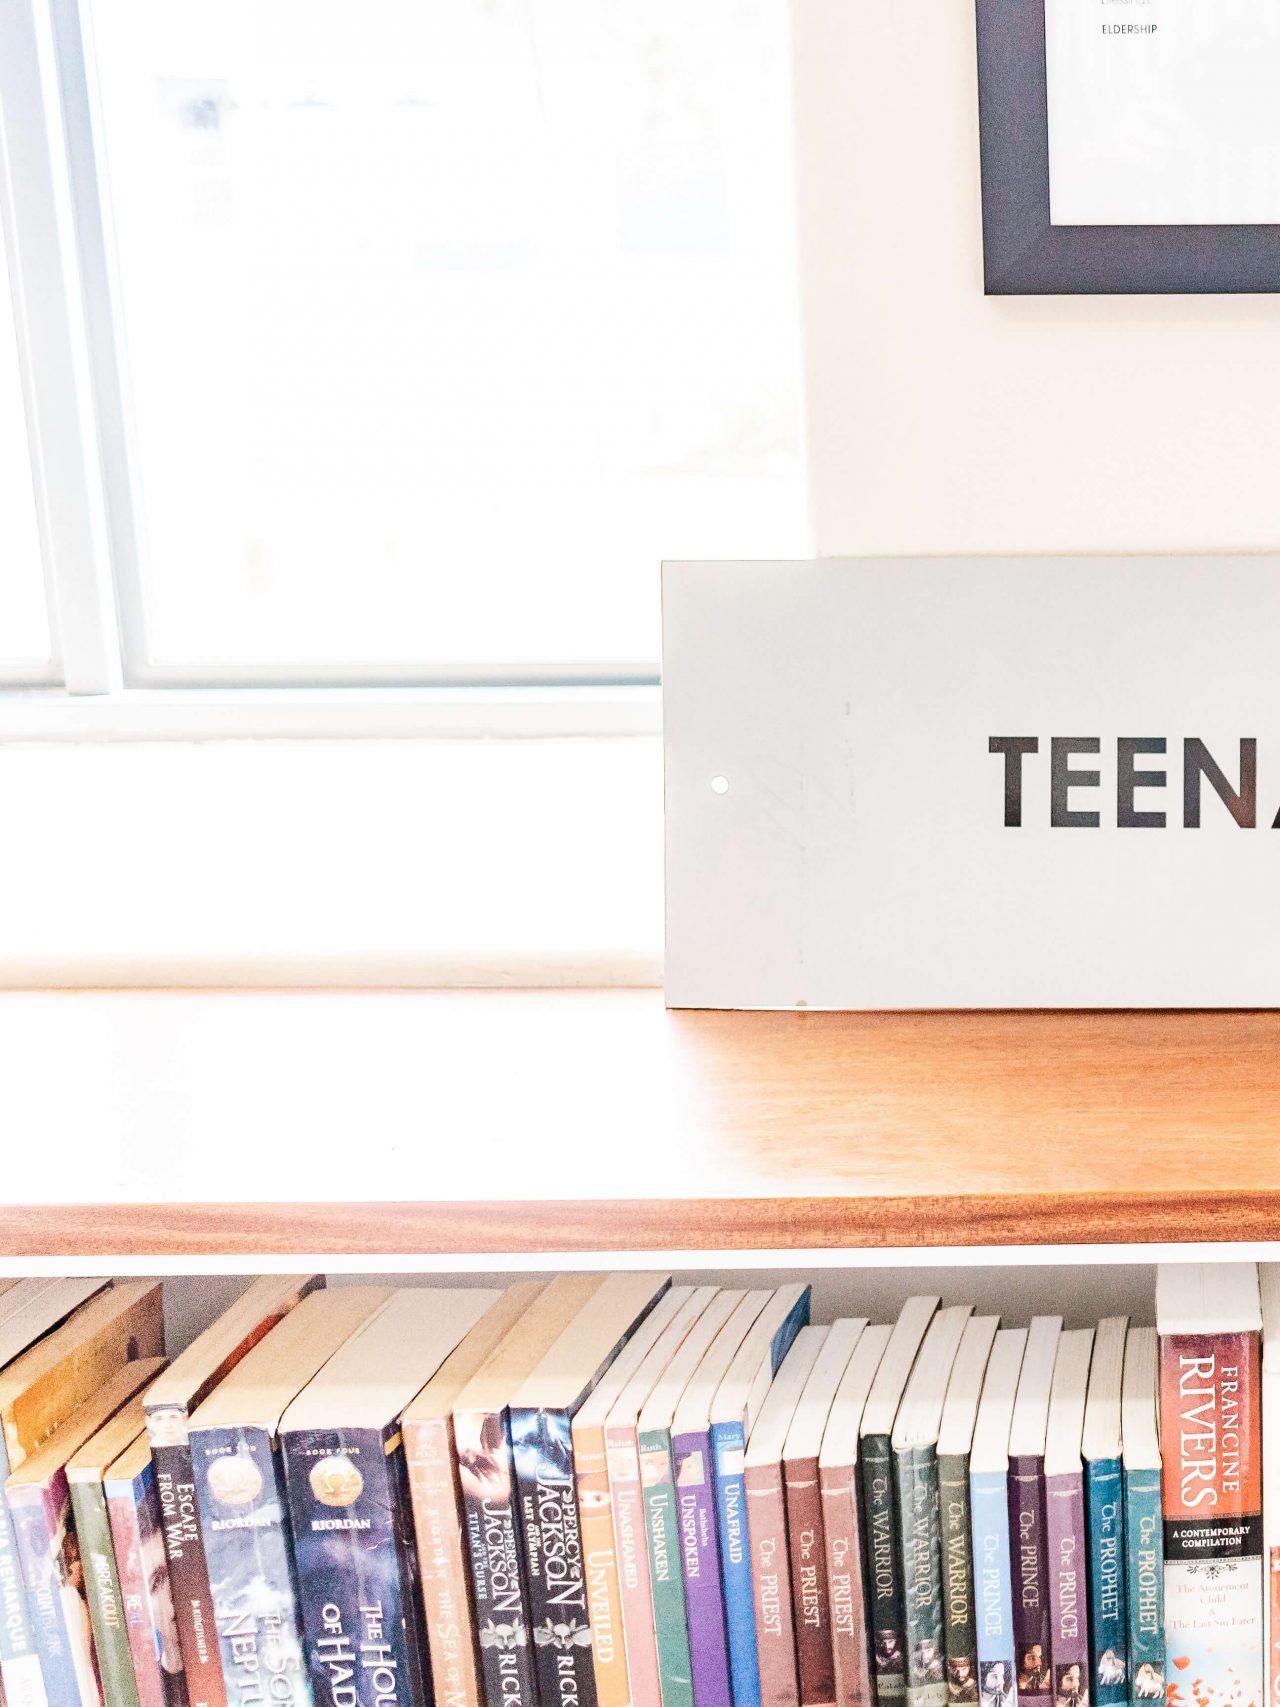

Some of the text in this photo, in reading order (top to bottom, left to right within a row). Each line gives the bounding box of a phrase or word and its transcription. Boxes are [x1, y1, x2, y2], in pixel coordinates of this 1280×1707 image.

[1102, 24, 1158, 34] ELDERSHIP
[336, 1447, 360, 1455] FOUR
[641, 1443, 662, 1452] Ruth
[718, 1432, 741, 1443] Mary
[1179, 1353, 1218, 1509] RIVERS
[1220, 1366, 1240, 1494] FRANCINE
[157, 1473, 183, 1560] FROM WAR
[176, 1484, 198, 1541] ESCAPE
[211, 1516, 271, 1531] RIORDAN
[311, 1518, 371, 1531] RIORDAN
[523, 1496, 534, 1521] LAST
[526, 1523, 540, 1576] OLYMPIAN
[536, 1466, 585, 1609] JACKSON
[562, 1503, 580, 1567] PERCY
[616, 1490, 638, 1589] UNASHAMED
[649, 1494, 669, 1582] UNSHAKEN
[680, 1494, 700, 1577] UNSPOKEN
[724, 1483, 743, 1564] UNAFRAID
[872, 1477, 894, 1600] The WARRIOR
[912, 1485, 935, 1608] The WARRIOR
[1173, 1526, 1251, 1539] A CONTEMPORARY
[1182, 1537, 1243, 1548] COMPILATION
[468, 1512, 488, 1600] TITAN'S CURSE
[482, 1497, 522, 1613] JACKSON
[502, 1526, 520, 1582] PERCY
[758, 1537, 783, 1637] The PRIEST
[800, 1529, 820, 1628] The PRIEST
[832, 1537, 854, 1637] The PRIEST
[947, 1501, 968, 1627] The WARRIOR
[982, 1534, 1003, 1637] The PRINCE
[1018, 1510, 1040, 1609] The PRINCE
[1059, 1535, 1079, 1640] The PRINCE
[1099, 1502, 1119, 1621] The PROPHET
[1138, 1515, 1159, 1635] The PROPHET
[1176, 1584, 1196, 1594] The
[1, 1554, 27, 1652] REMARQUE
[322, 1603, 343, 1635] OF
[359, 1600, 383, 1640] THE
[587, 1551, 614, 1664] UNVEILED
[1173, 1619, 1191, 1630] The
